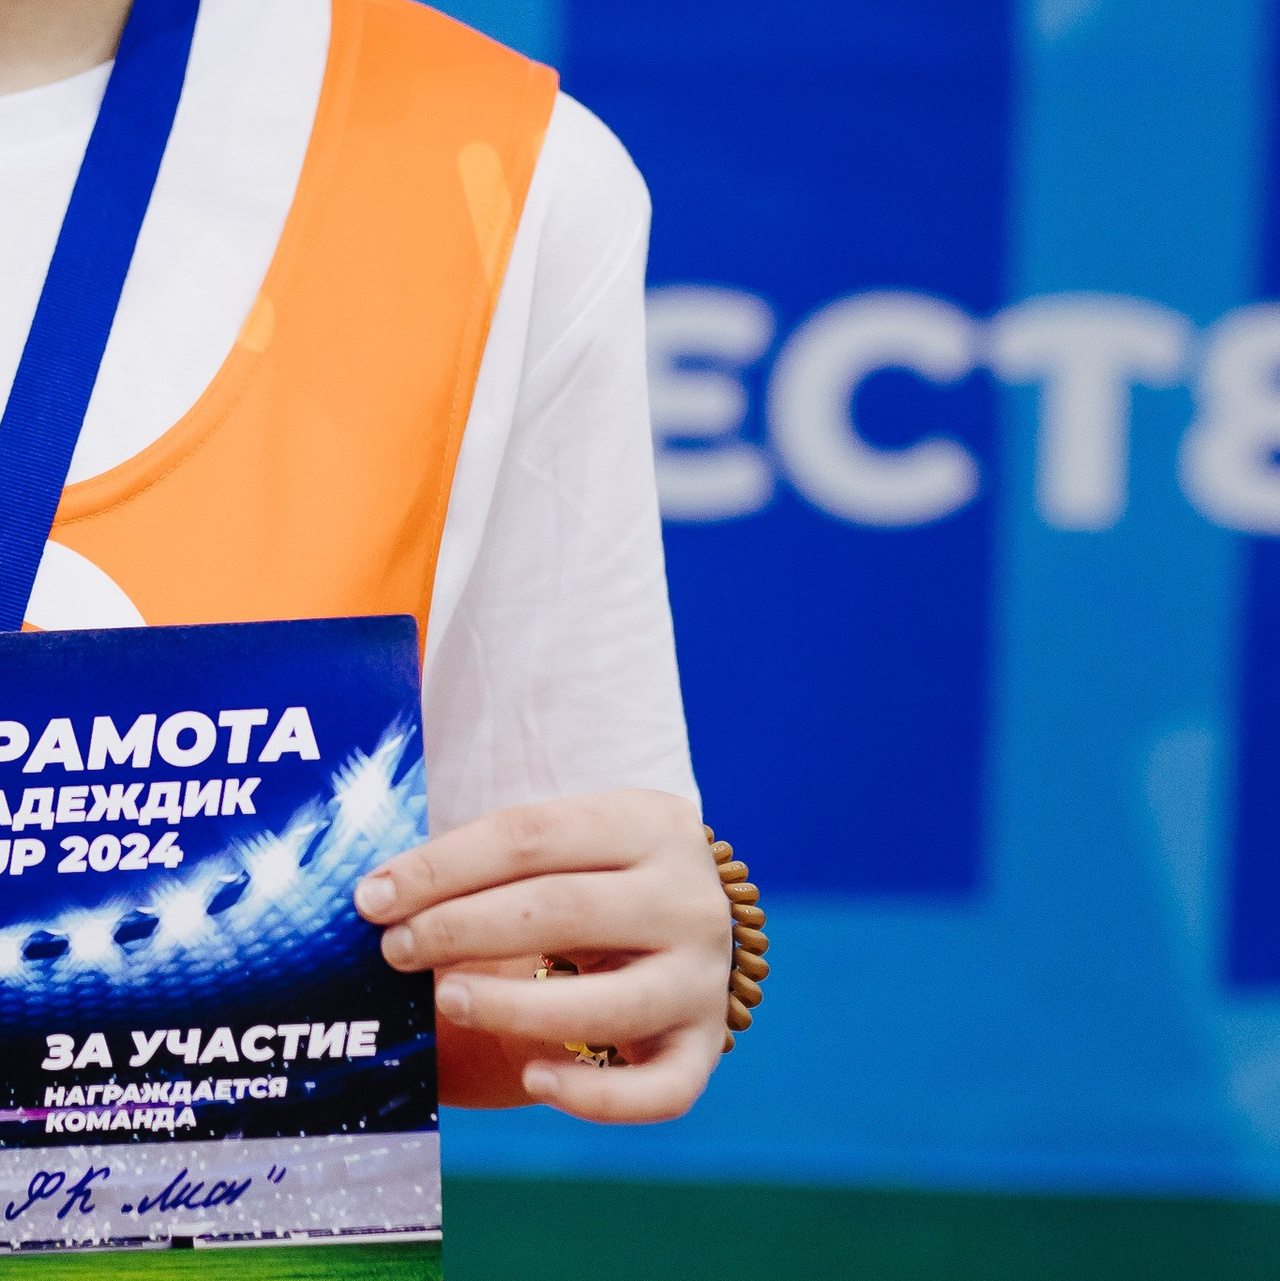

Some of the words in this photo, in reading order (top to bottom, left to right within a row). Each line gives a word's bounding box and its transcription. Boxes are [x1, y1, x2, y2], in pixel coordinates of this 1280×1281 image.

[57, 832, 184, 874] 2024
[41, 1032, 113, 1070] ЗА
[129, 1021, 380, 1068] УЧАСТИЕ
[44, 1076, 288, 1107] НАГРАЖДАЕТСЯ
[45, 1107, 197, 1133] КОМАНДА
